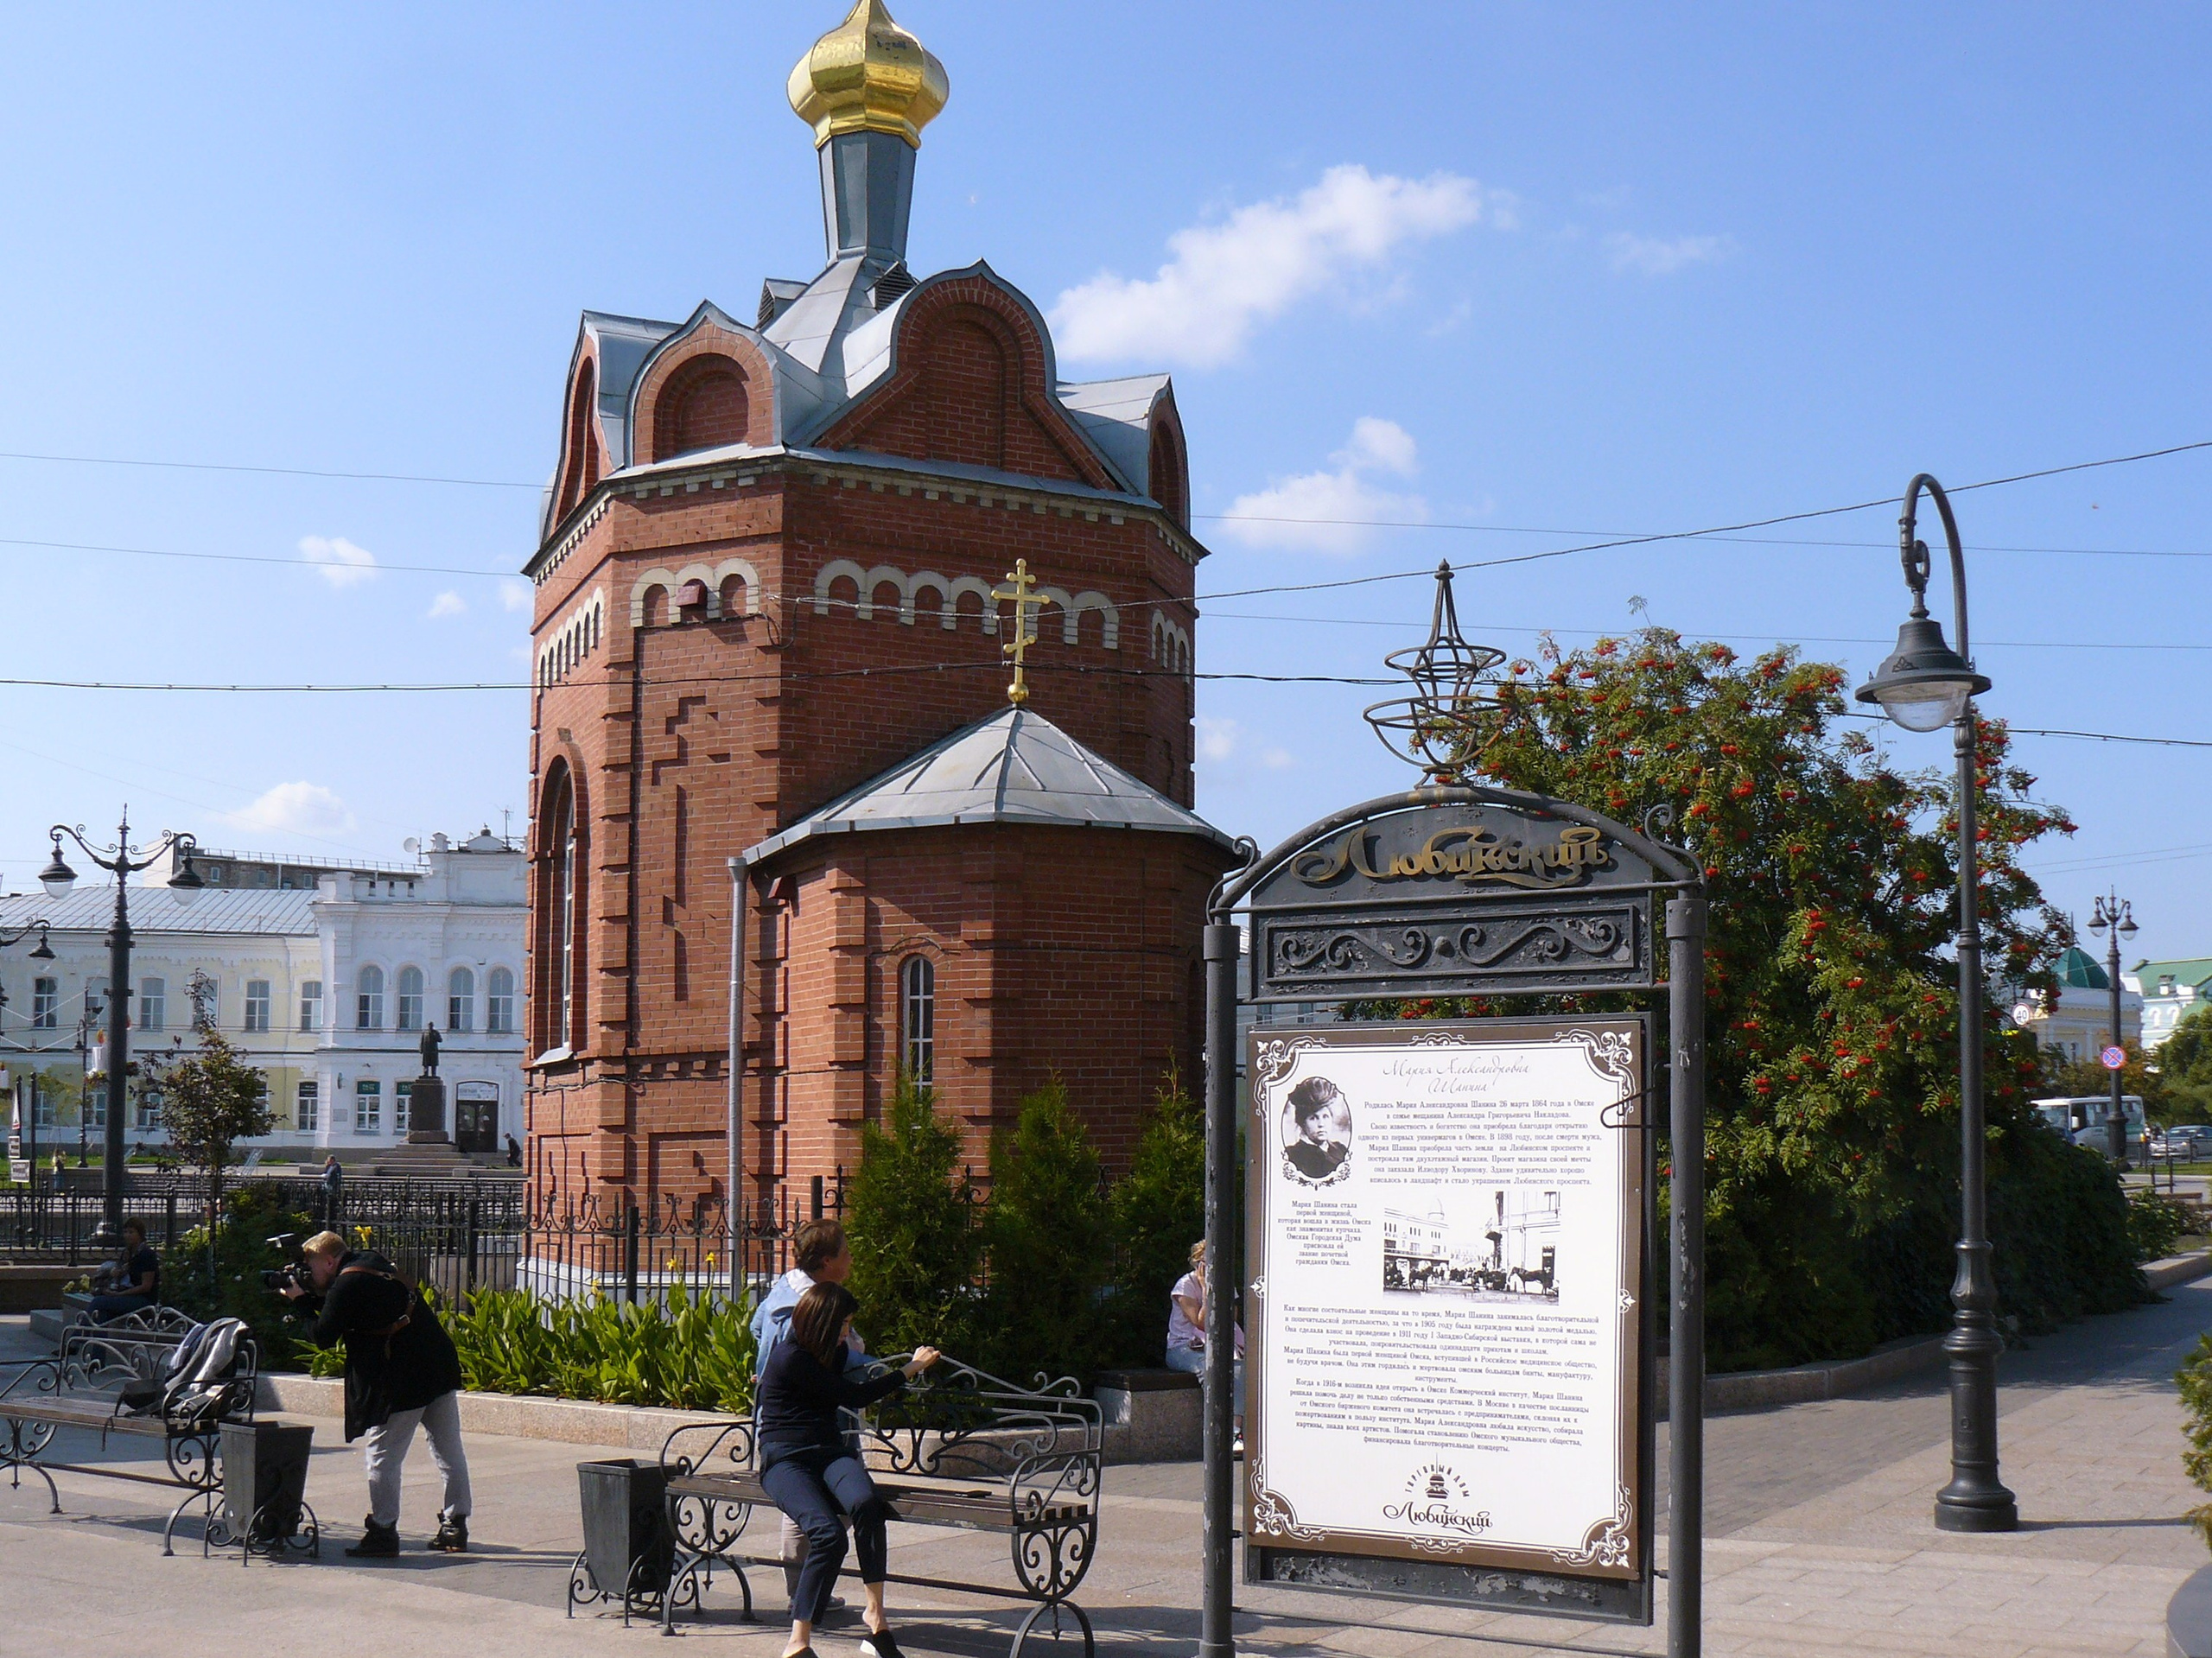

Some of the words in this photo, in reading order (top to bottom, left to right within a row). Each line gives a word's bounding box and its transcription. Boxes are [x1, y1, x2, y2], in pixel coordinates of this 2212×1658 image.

[1290, 825, 1609, 888] Любинский
[2017, 1010, 2028, 1020] 40
[1383, 1059, 1432, 1087] Мария
[1436, 1055, 1529, 1086] Александровна
[1428, 1077, 1487, 1094] Шанина
[1396, 1101, 1416, 1109] Мария
[1446, 1111, 1484, 1120] Александра
[1488, 1110, 1530, 1120] Григорьевича
[1419, 1144, 1452, 1153] приобрела
[1491, 1154, 1515, 1163] Проект
[1417, 1166, 1448, 1174] Илиодору
[1383, 1502, 1493, 1535] Любинский
